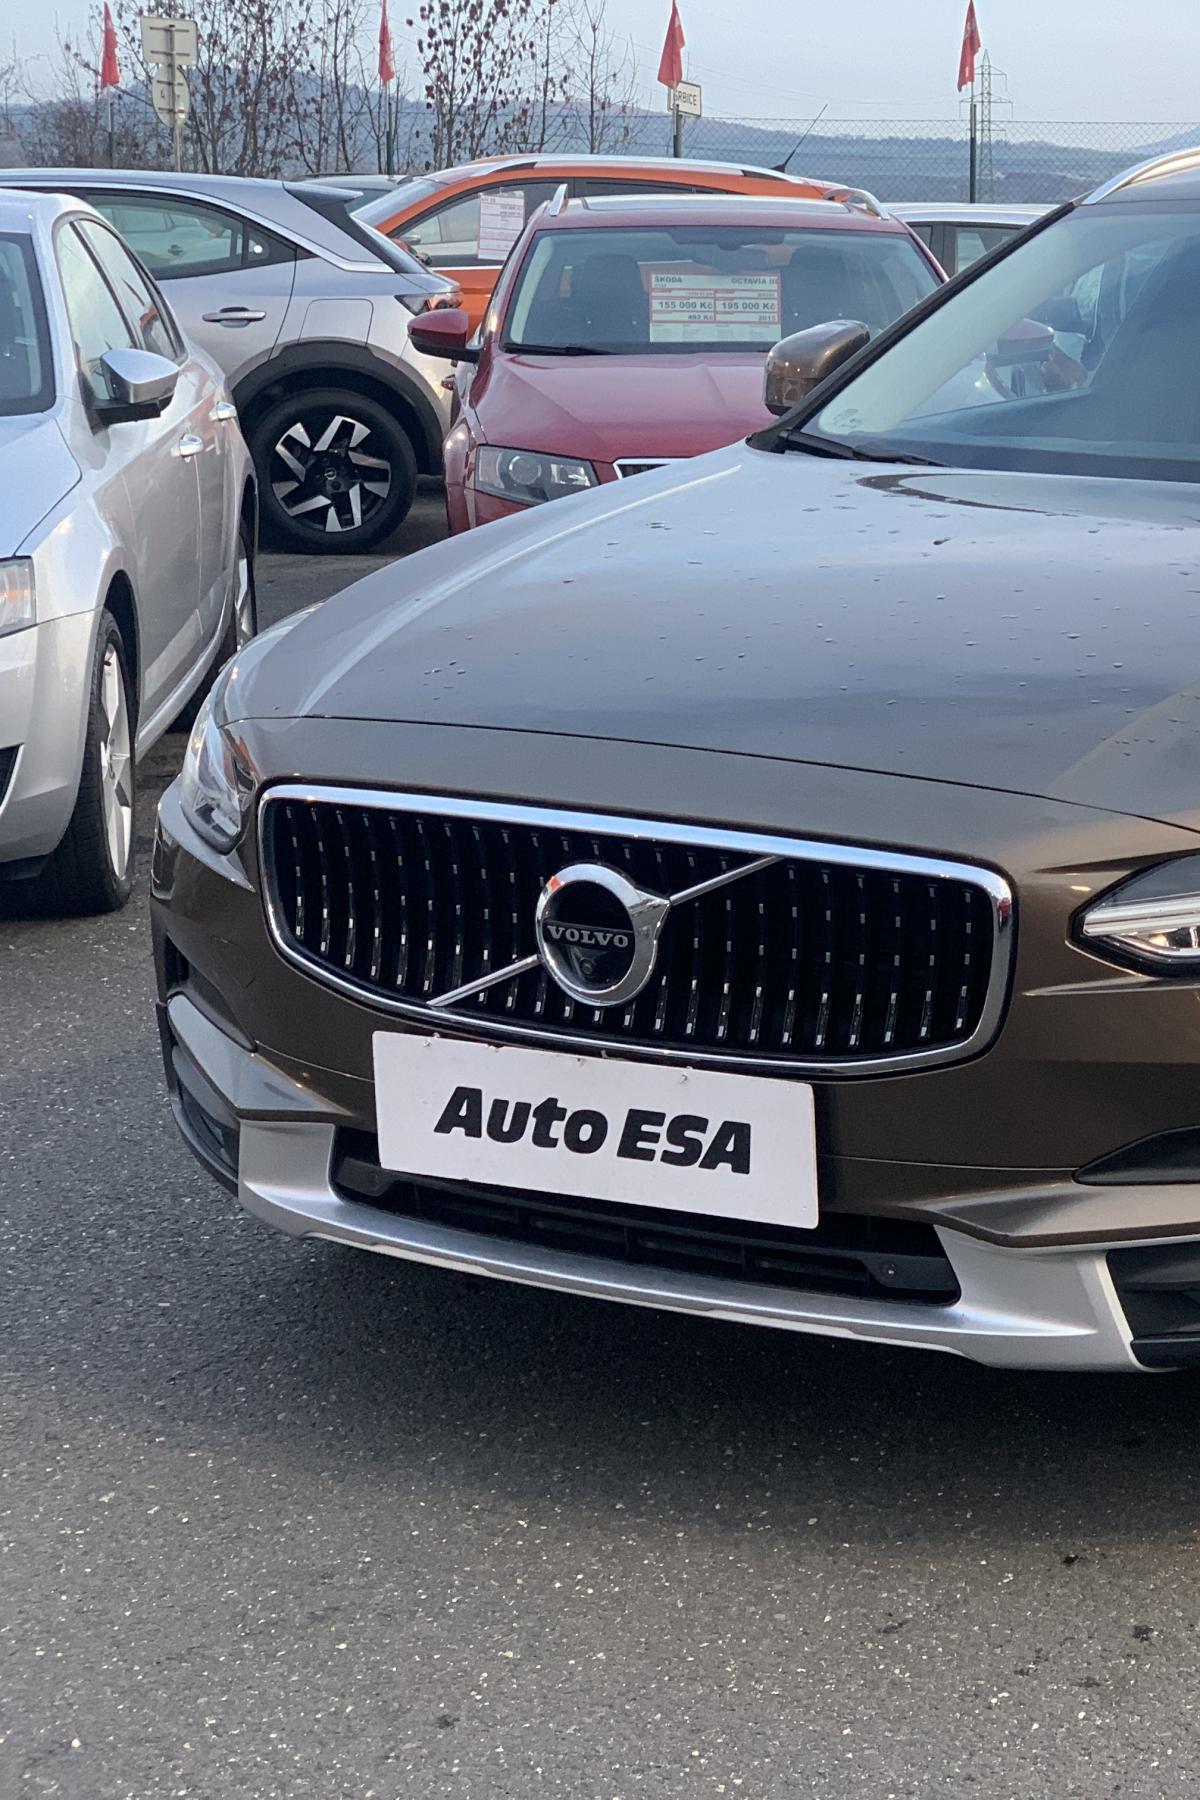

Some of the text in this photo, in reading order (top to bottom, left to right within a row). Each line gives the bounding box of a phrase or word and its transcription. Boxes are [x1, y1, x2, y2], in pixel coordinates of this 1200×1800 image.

[654, 275, 683, 284] ŠKODA
[731, 277, 767, 285] OCTAVIA
[659, 301, 713, 309] 155 000 Kč
[722, 302, 775, 310] 195 000 Kč
[547, 925, 629, 948] VOLVO
[434, 1086, 751, 1174] Auto ESA
